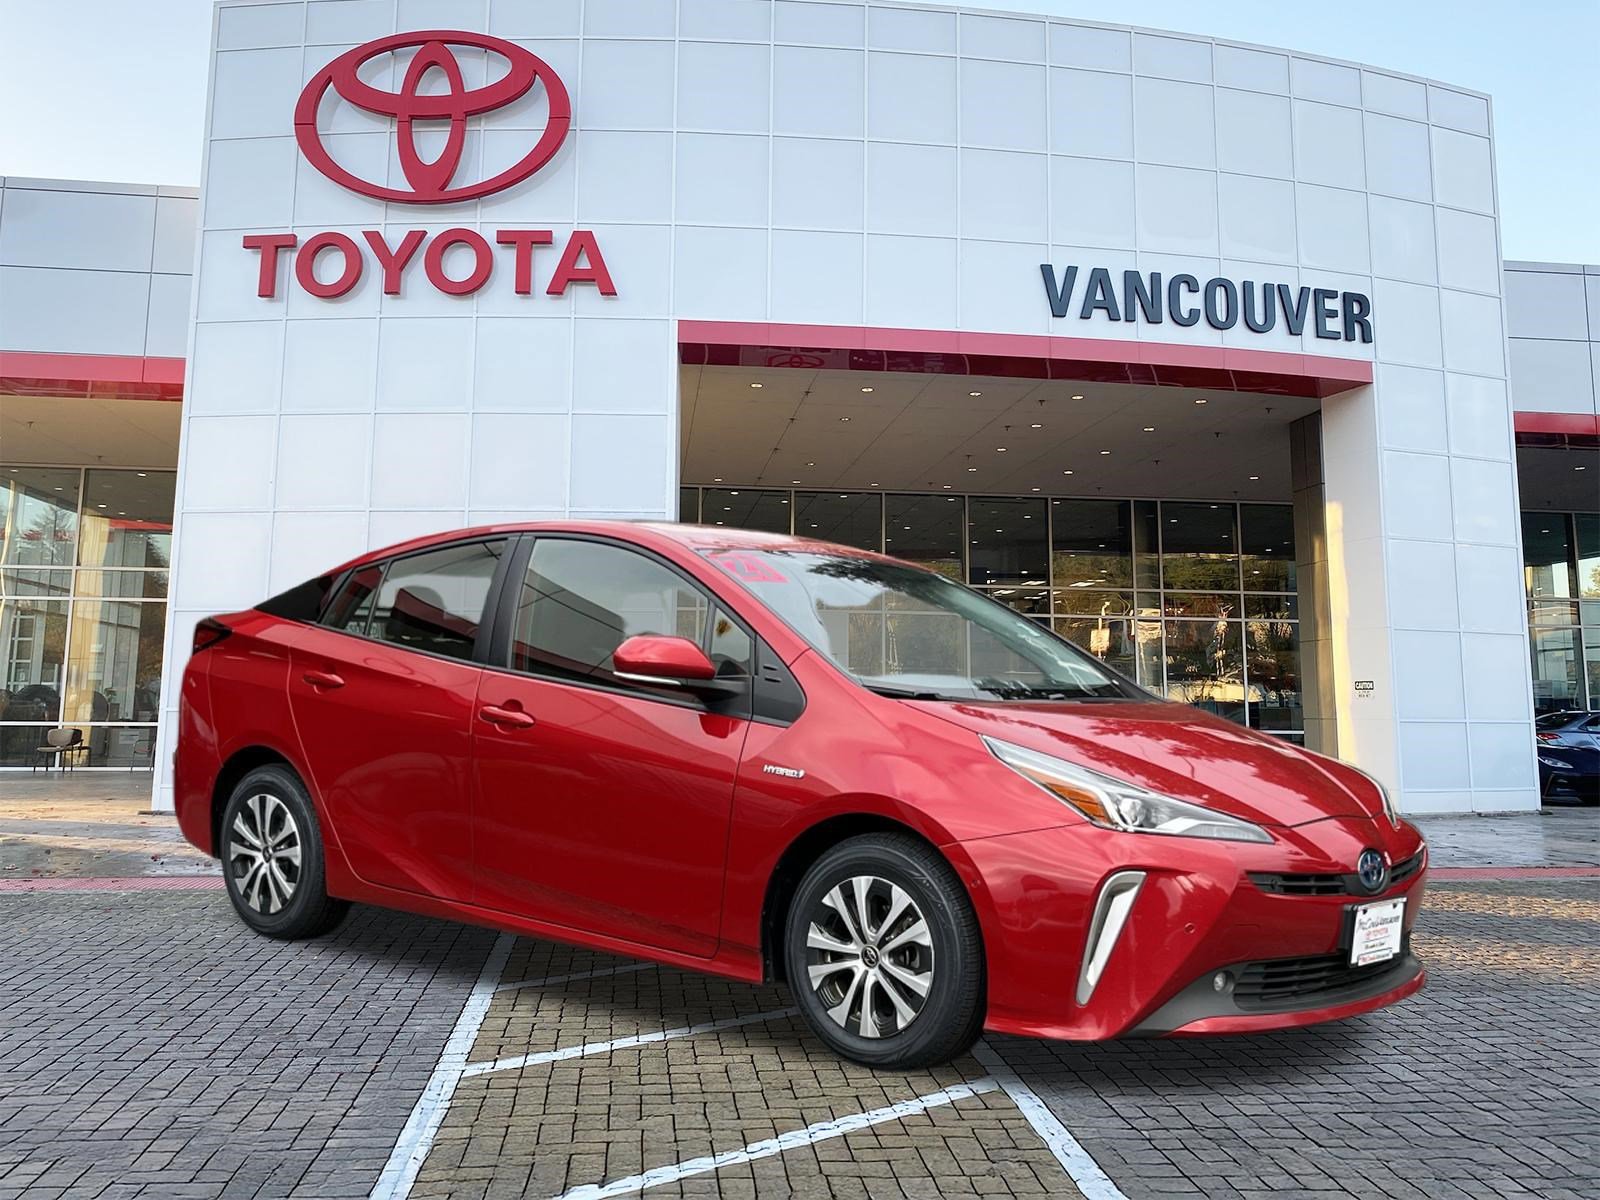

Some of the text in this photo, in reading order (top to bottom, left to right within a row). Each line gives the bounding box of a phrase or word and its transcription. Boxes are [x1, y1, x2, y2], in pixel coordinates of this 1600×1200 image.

[242, 227, 618, 299] TOYOTA
[1040, 264, 1373, 343] VANCOUVER
[763, 764, 798, 778] HYBRID
